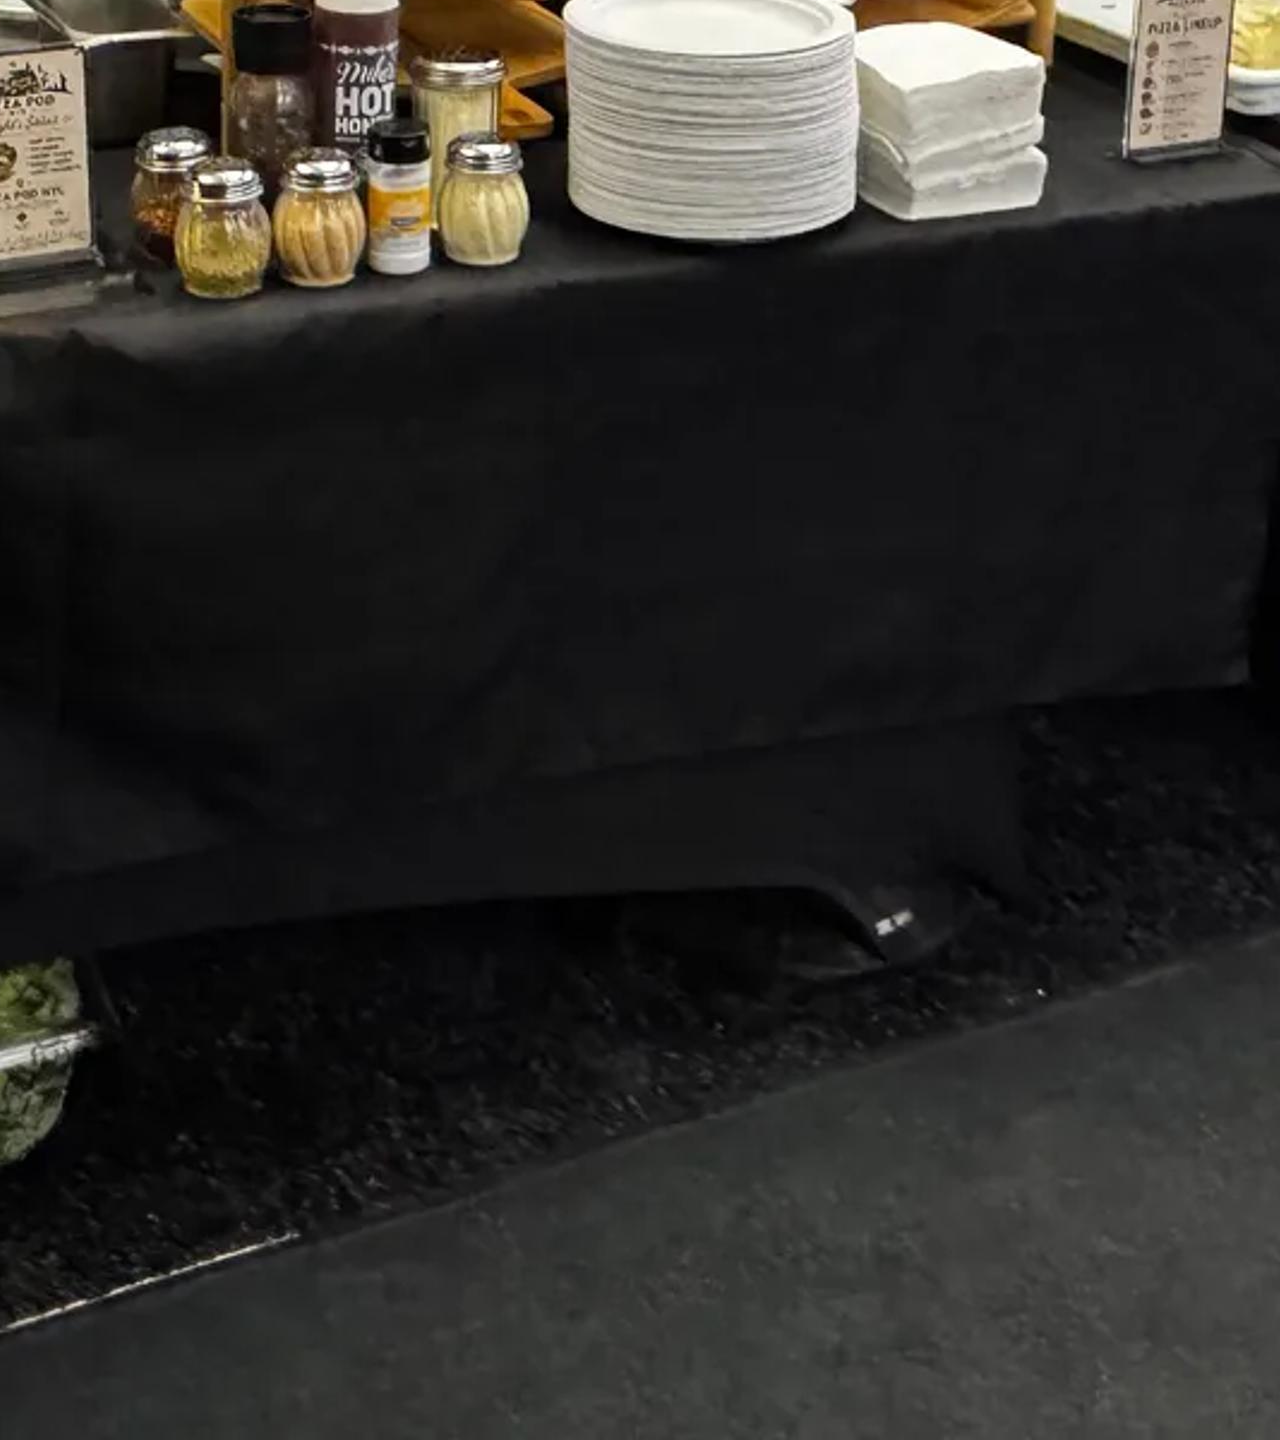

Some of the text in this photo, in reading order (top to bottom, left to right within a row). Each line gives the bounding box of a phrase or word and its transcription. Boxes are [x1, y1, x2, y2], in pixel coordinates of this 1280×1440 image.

[25, 95, 55, 107] POD
[335, 83, 395, 117] HOT
[335, 114, 392, 135] HON
